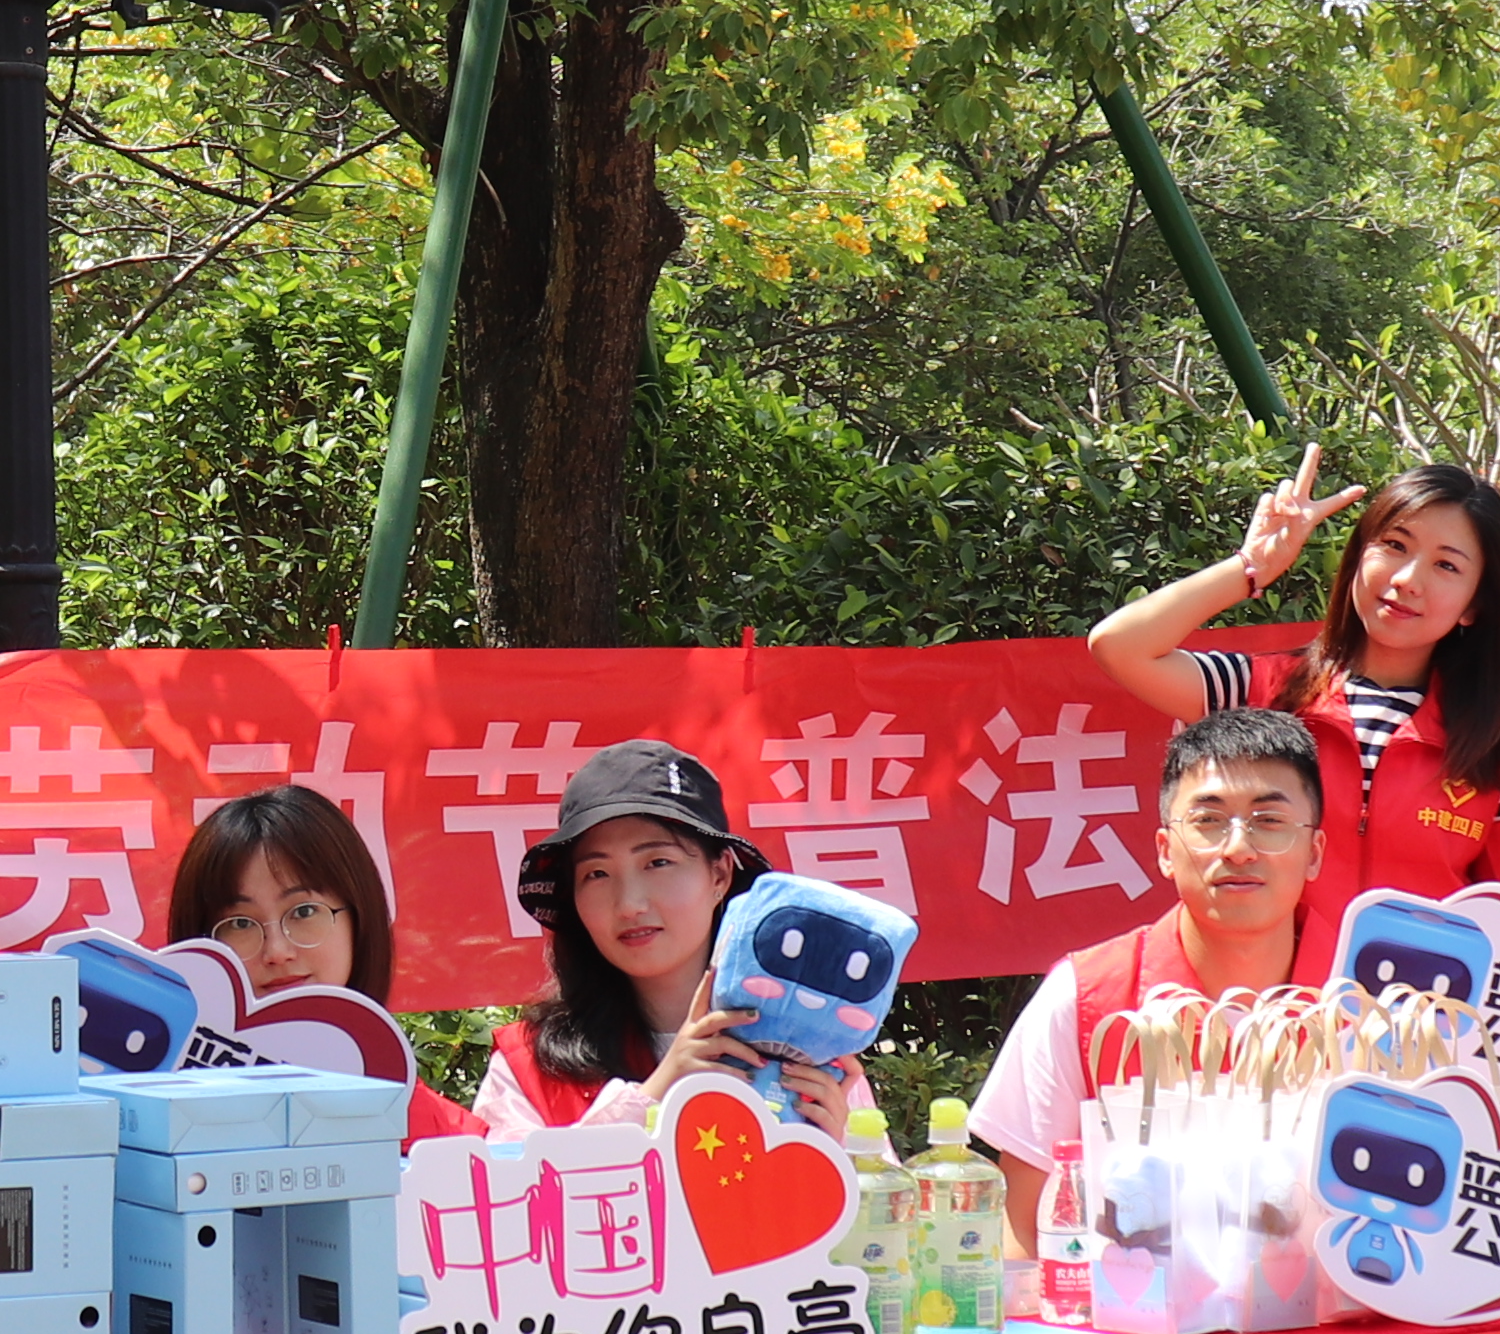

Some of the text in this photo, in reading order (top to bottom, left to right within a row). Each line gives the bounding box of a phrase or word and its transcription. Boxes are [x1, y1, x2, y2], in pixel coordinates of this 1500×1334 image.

[1417, 806, 1485, 842] 中建四局
[419, 1147, 666, 1322] 中国
